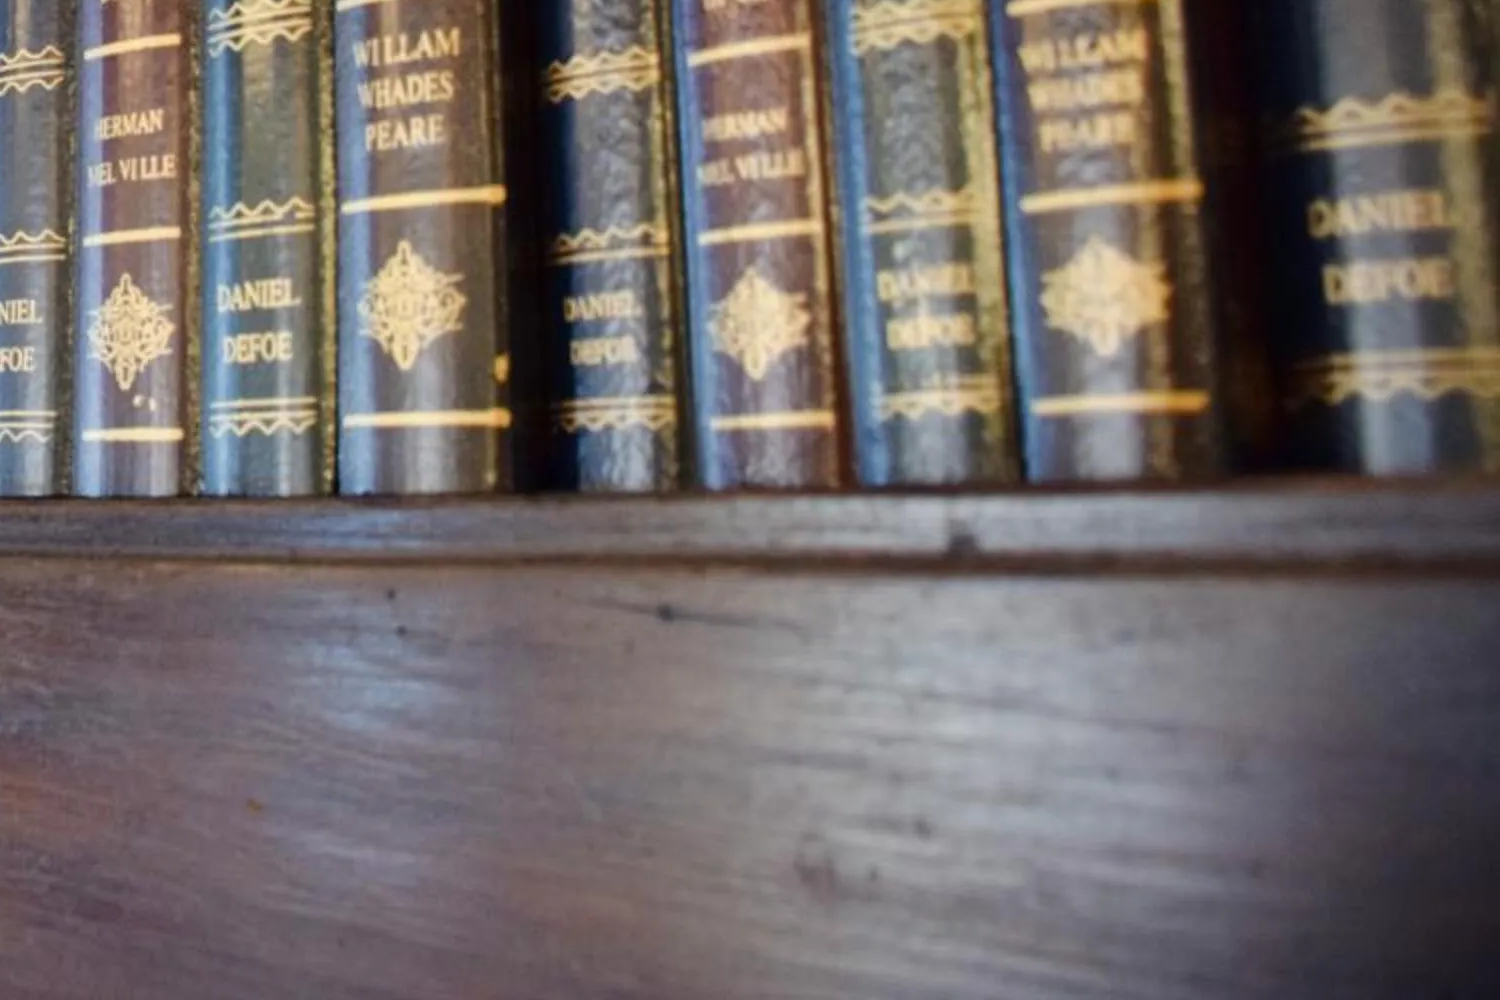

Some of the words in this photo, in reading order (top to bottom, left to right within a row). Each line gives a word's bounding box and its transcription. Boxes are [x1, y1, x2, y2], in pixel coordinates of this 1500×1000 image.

[365, 113, 446, 152] PEARE
[216, 277, 302, 313] DANIEL
[222, 331, 294, 365] DEFOE
